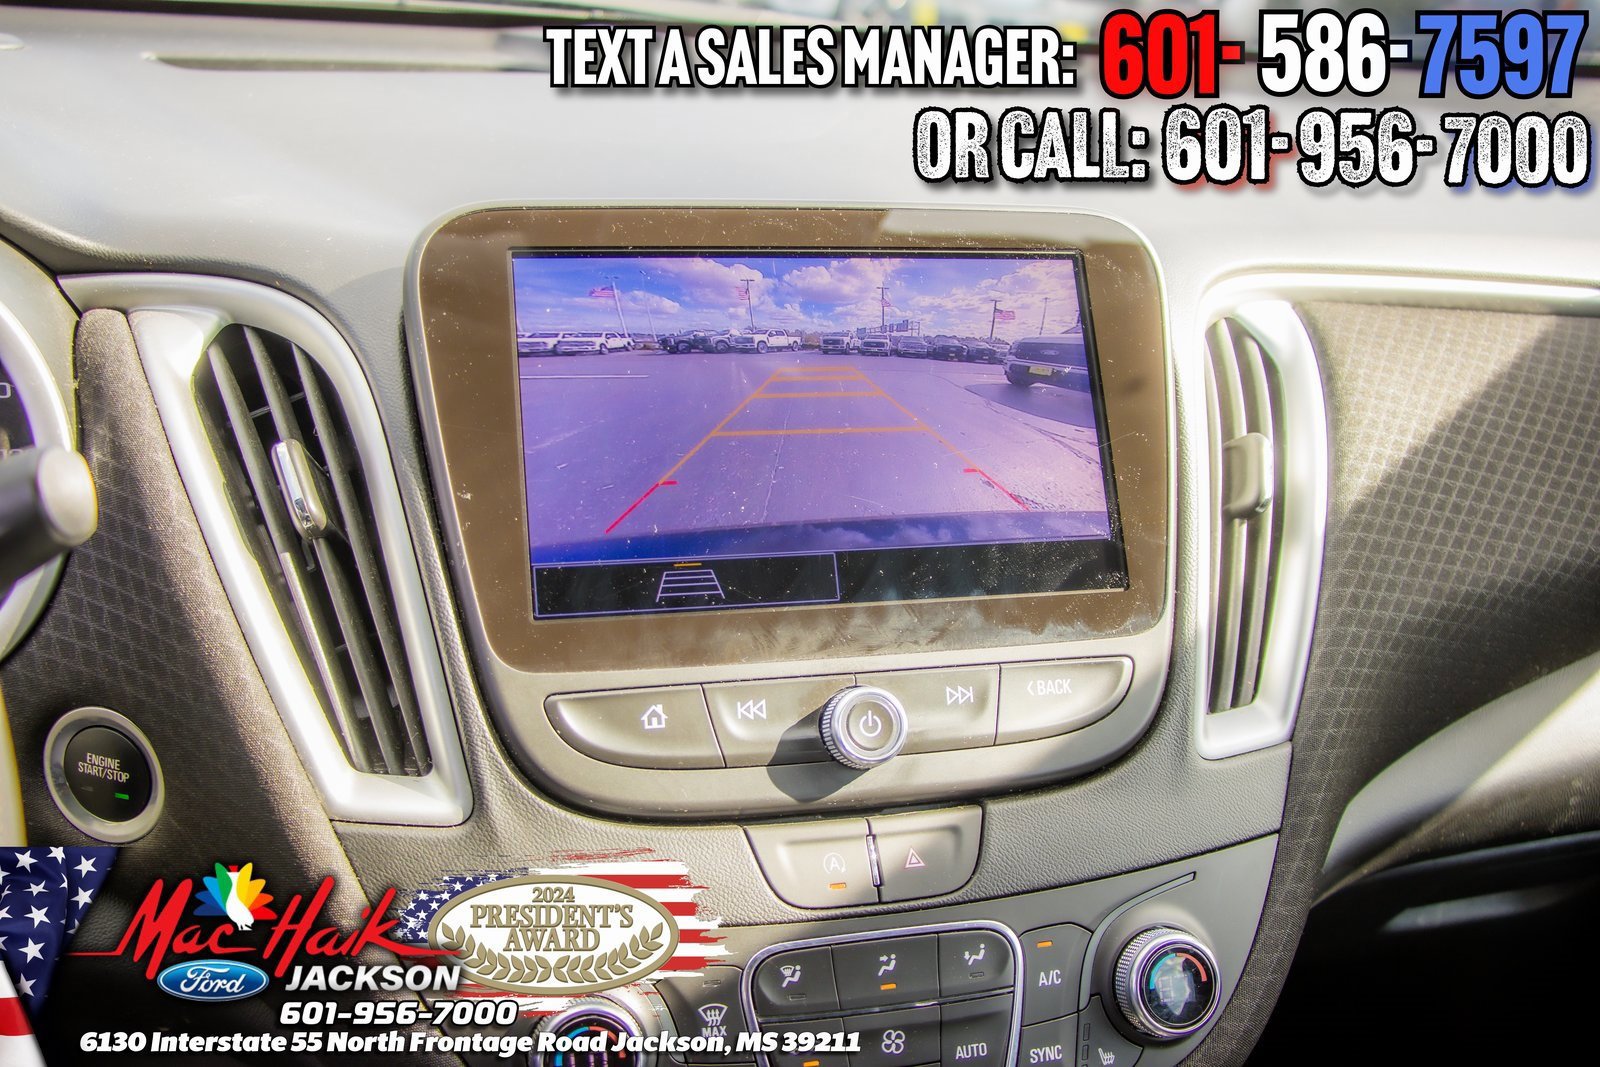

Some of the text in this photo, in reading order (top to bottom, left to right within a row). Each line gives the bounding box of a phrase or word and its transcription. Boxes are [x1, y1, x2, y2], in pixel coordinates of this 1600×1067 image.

[1036, 678, 1073, 696] BACK
[86, 752, 121, 771] ENGINE
[78, 761, 130, 783] START/STOP
[1038, 969, 1062, 987] A/C
[701, 1025, 728, 1038] MAX
[955, 1042, 988, 1060] AUTO
[1029, 1044, 1063, 1064] SYNC
